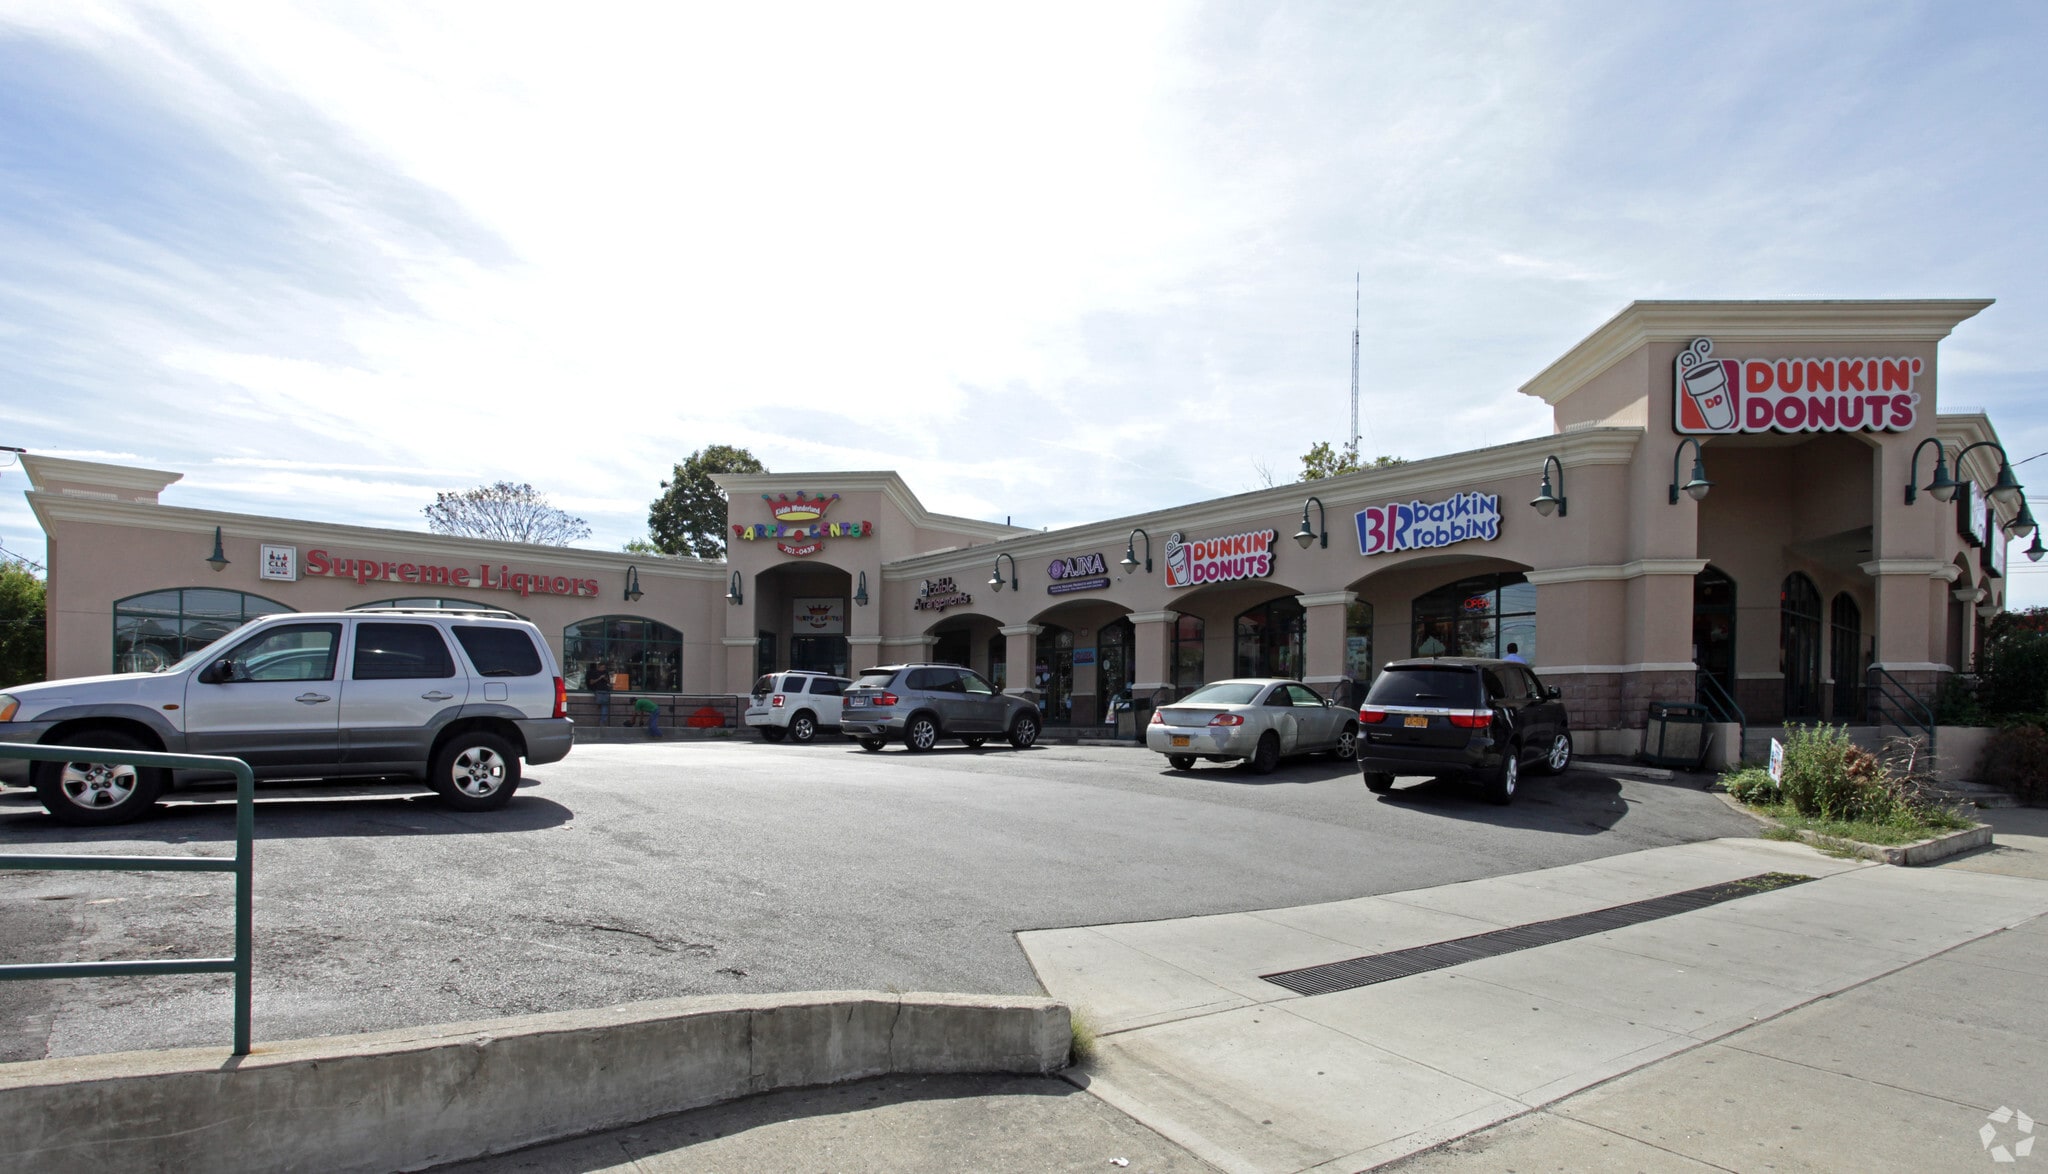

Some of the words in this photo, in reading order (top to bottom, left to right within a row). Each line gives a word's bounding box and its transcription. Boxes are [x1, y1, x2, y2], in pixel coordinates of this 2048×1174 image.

[1746, 358, 1921, 394] DUNKIN'
[1704, 394, 1723, 409] DD
[1746, 394, 1913, 429] DONUTS
[791, 504, 821, 515] Wonderland
[1413, 493, 1496, 524] baskin
[732, 521, 788, 541] PARTY
[809, 520, 873, 538] CENTER
[1355, 504, 1414, 553] BR
[1413, 517, 1496, 548] robbins
[783, 545, 816, 556] 701-0439
[1193, 531, 1272, 562] DUNKIN'
[306, 549, 471, 587] Supreme
[480, 564, 599, 598] Liquors
[1062, 553, 1105, 578] AJNA
[1193, 555, 1268, 582] DONUTS
[929, 577, 957, 595] Edible
[913, 592, 973, 612] Arrangements
[1463, 598, 1490, 609] OPEN
